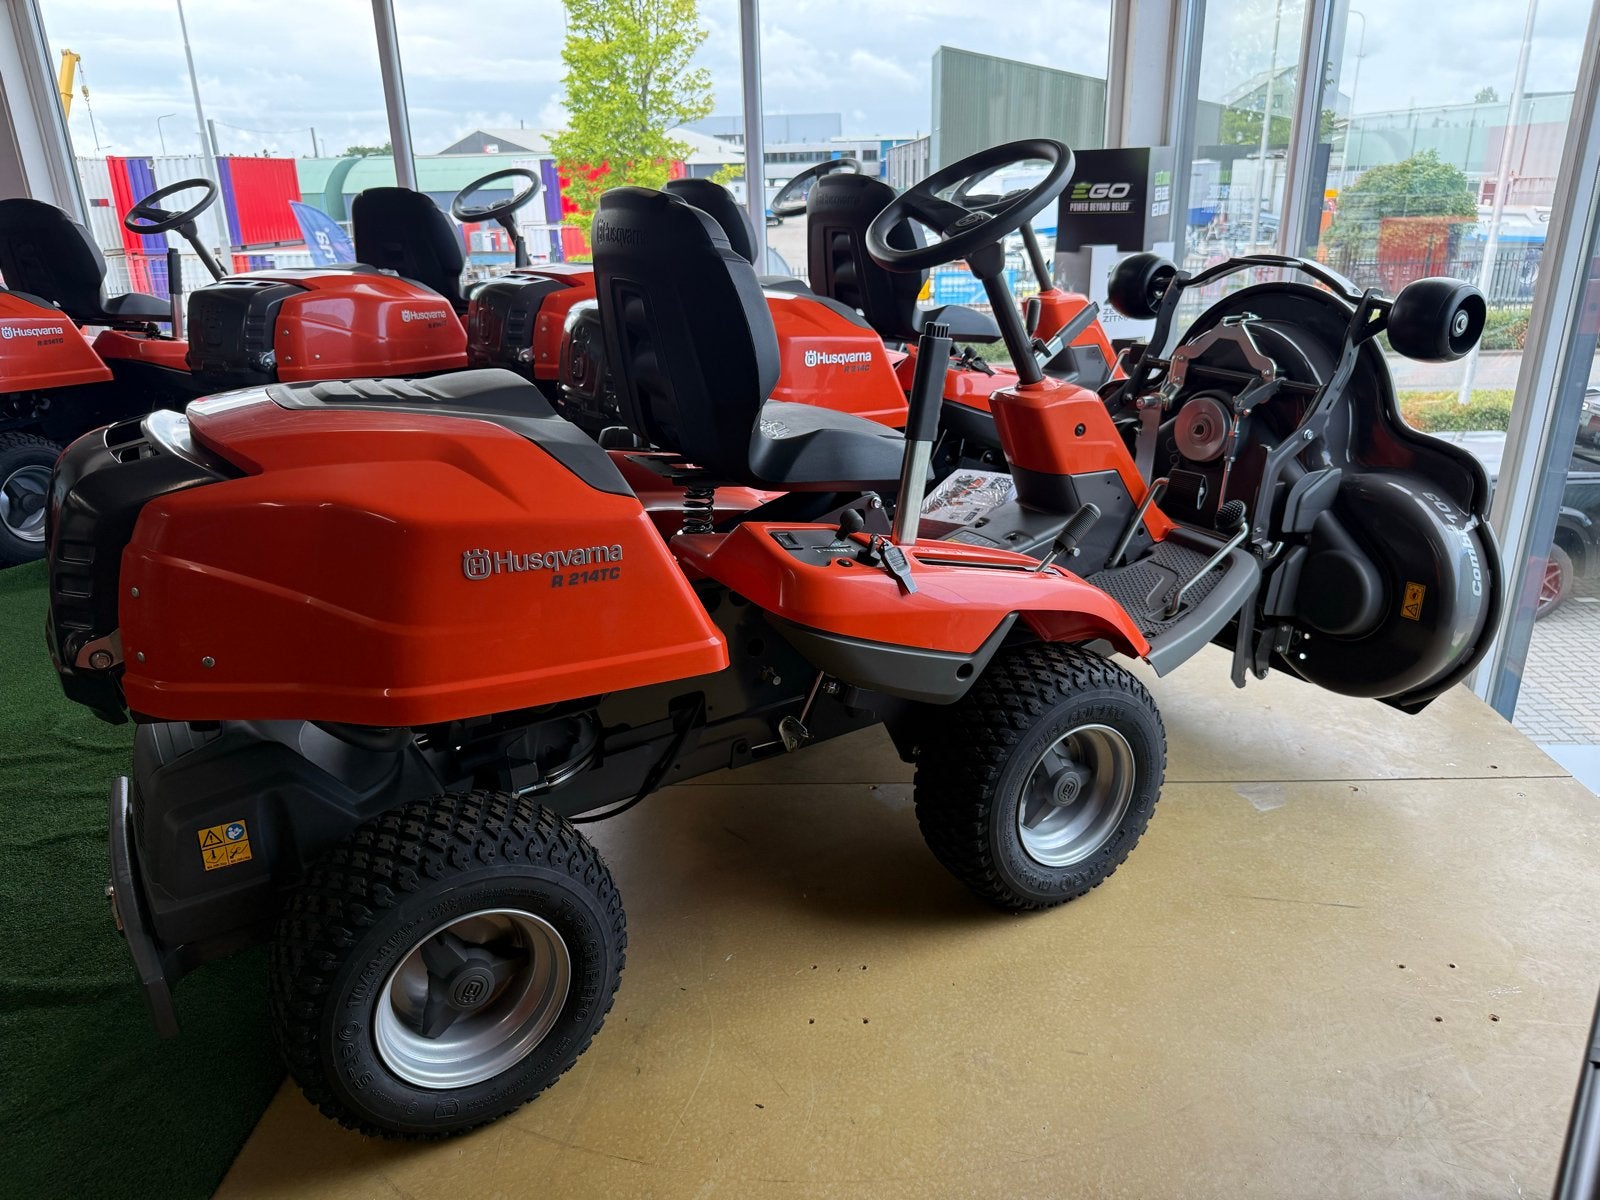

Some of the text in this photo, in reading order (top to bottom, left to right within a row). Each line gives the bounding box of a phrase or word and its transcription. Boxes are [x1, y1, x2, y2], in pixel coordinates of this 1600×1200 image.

[1070, 182, 1131, 199] EGO
[1069, 201, 1130, 212] POWER BEYOND BELIEF
[411, 310, 446, 320] Husqvarna
[13, 326, 63, 337] Husqvarna
[817, 352, 871, 365] Husqvarna
[1422, 492, 1458, 524] 103
[493, 544, 623, 574] Husqvarna
[551, 567, 620, 588] R 214TC
